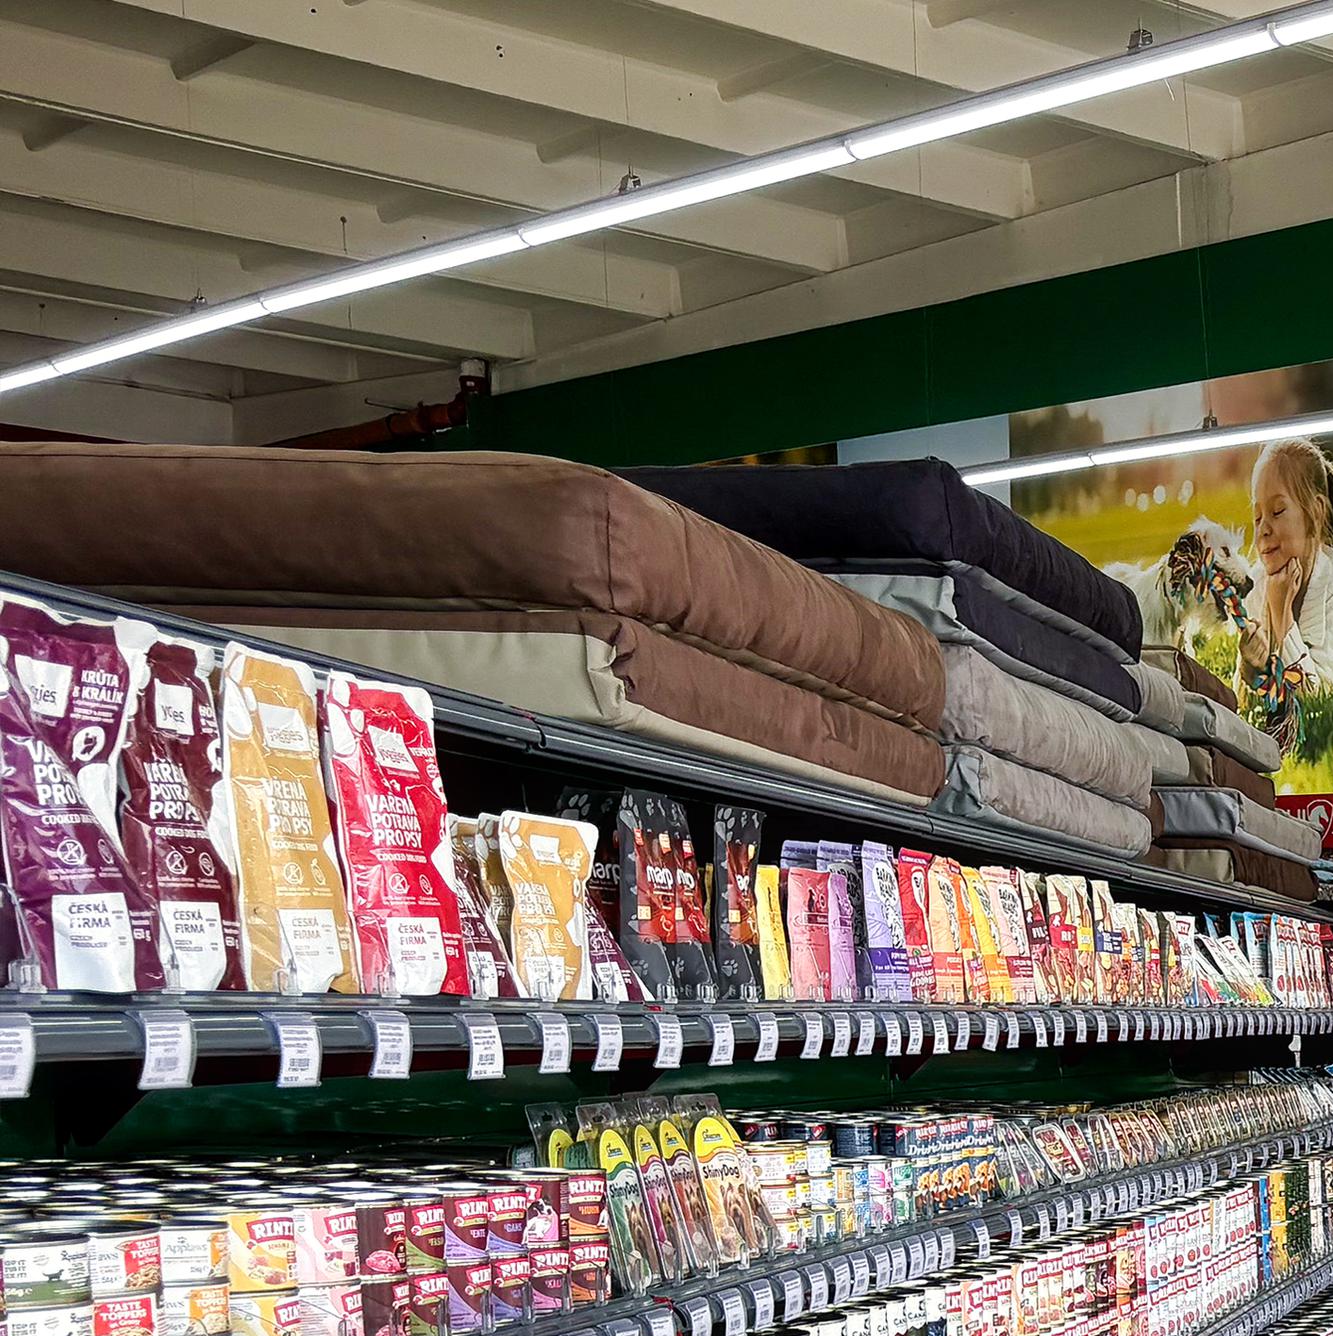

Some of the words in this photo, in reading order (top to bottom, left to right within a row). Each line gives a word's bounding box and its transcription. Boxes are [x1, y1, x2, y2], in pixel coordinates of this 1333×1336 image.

[68, 902, 108, 915] ČESKÁ
[173, 910, 203, 921] ČESKÁ
[174, 923, 205, 934] FIRMA
[398, 923, 423, 934] ČESKÁ
[399, 935, 427, 946] FIRMA
[703, 1164, 739, 1180] ShinyDog
[106, 1302, 142, 1312] TASTE
[101, 1310, 147, 1321] TOPPERS
